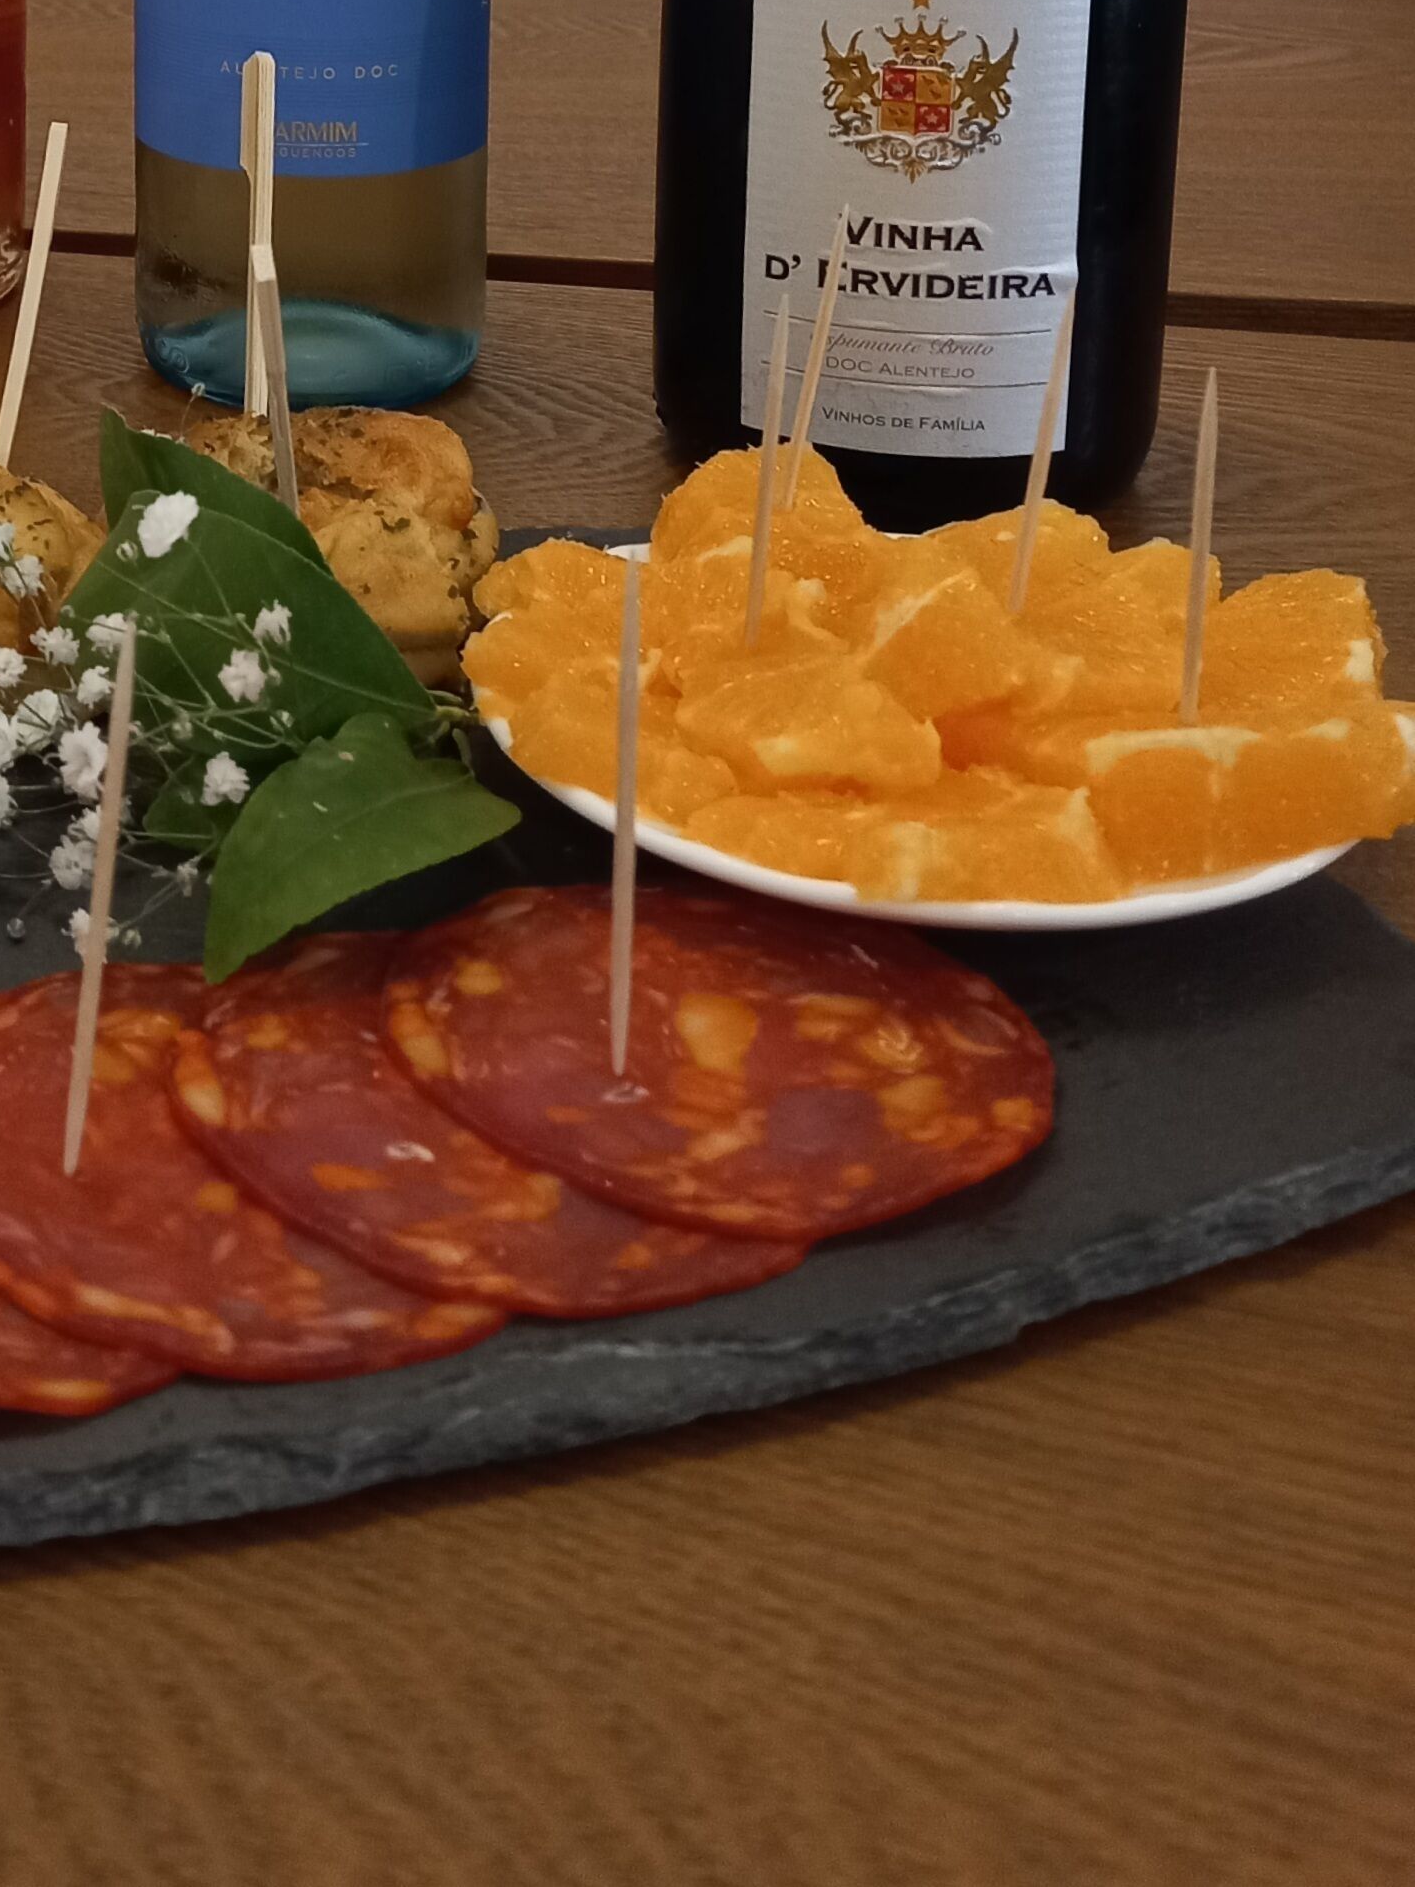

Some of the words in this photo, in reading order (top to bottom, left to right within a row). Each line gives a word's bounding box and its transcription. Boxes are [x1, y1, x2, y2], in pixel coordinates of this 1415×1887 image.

[220, 59, 337, 80] ALTEJO
[354, 64, 400, 80] DOC
[274, 120, 359, 143] ARMIM
[277, 147, 357, 159] GUENGOS
[838, 212, 985, 252] VINHA
[811, 331, 921, 357] spumante
[928, 338, 995, 356] Bruto
[825, 355, 873, 373] DOC
[879, 362, 976, 379] ALENTEJO
[822, 406, 886, 428] VINHOS
[891, 416, 914, 429] DE
[919, 414, 986, 432] FAMÍLIA
